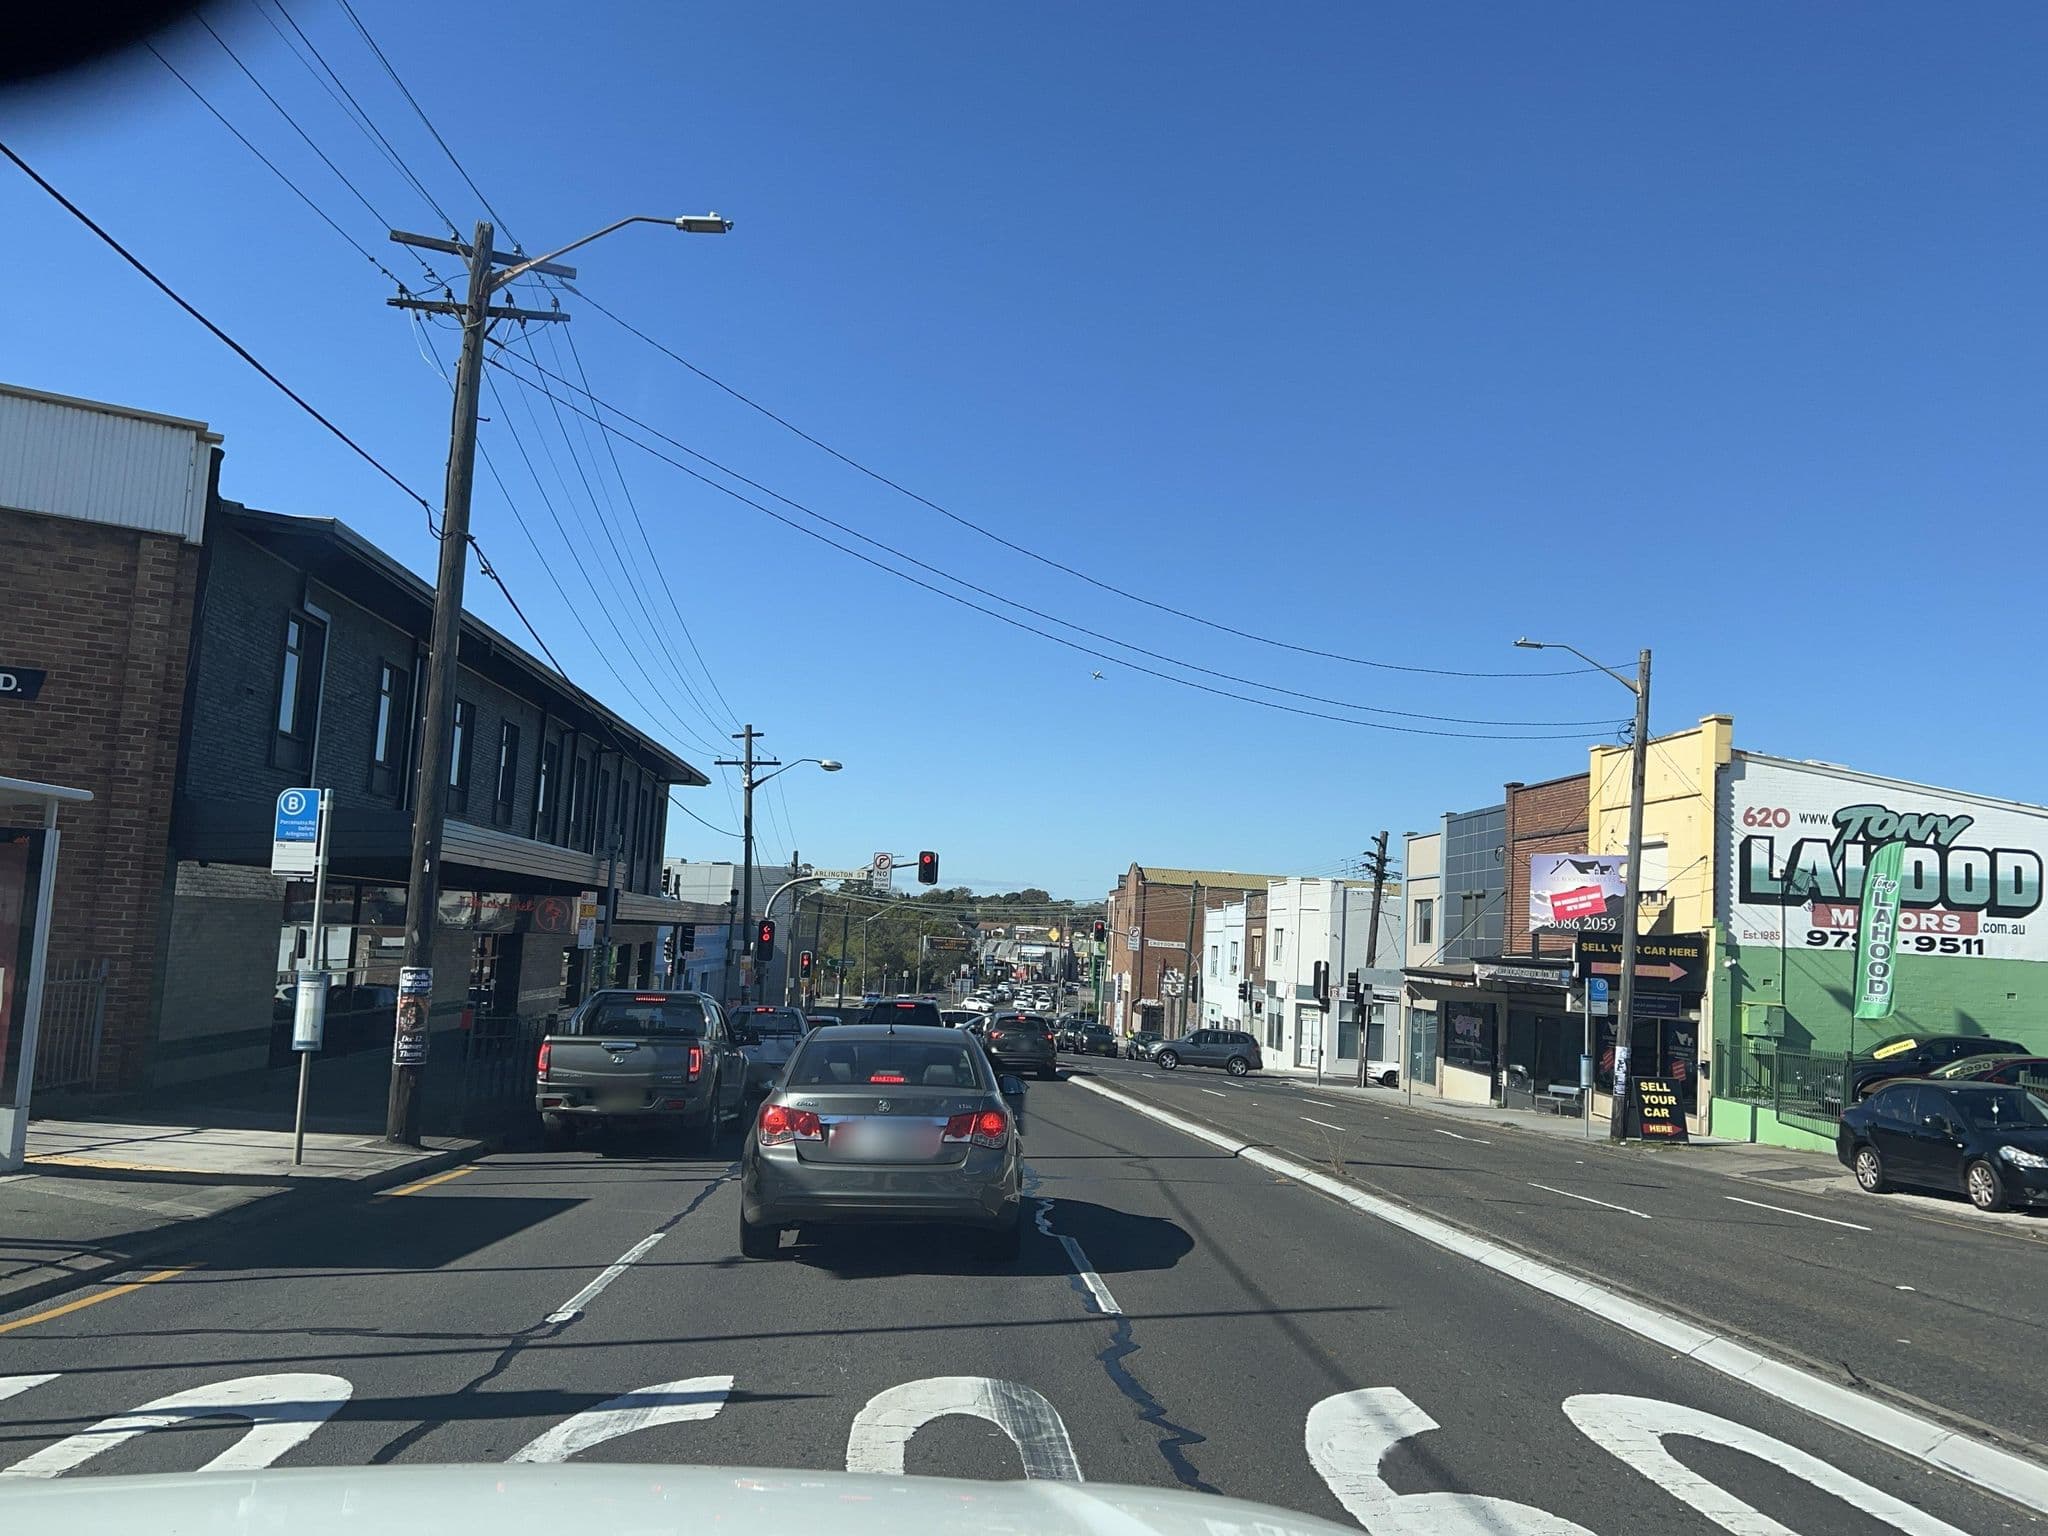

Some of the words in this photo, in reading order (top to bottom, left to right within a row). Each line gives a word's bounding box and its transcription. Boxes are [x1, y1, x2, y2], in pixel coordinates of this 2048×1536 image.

[0, 673, 22, 691] D.
[288, 797, 299, 810] B
[1743, 807, 1791, 829] 620
[1799, 813, 1831, 825] www.
[1871, 874, 1897, 894] Tony
[1584, 917, 1616, 931] 2059
[1831, 908, 1960, 933] MORS
[1979, 923, 2026, 936] .com.au
[1581, 942, 1608, 952] SELL
[1611, 944, 1640, 954] YOR
[1644, 946, 1666, 955] CAR
[1669, 947, 1698, 957] HERE
[1806, 930, 1985, 955] 97-9511
[1867, 891, 1893, 996] LAHOOD
[1640, 1081, 1671, 1092] SELL
[1642, 1095, 1677, 1105] YOUR
[1644, 1108, 1670, 1117] CAR
[1649, 1124, 1673, 1133] HERE
